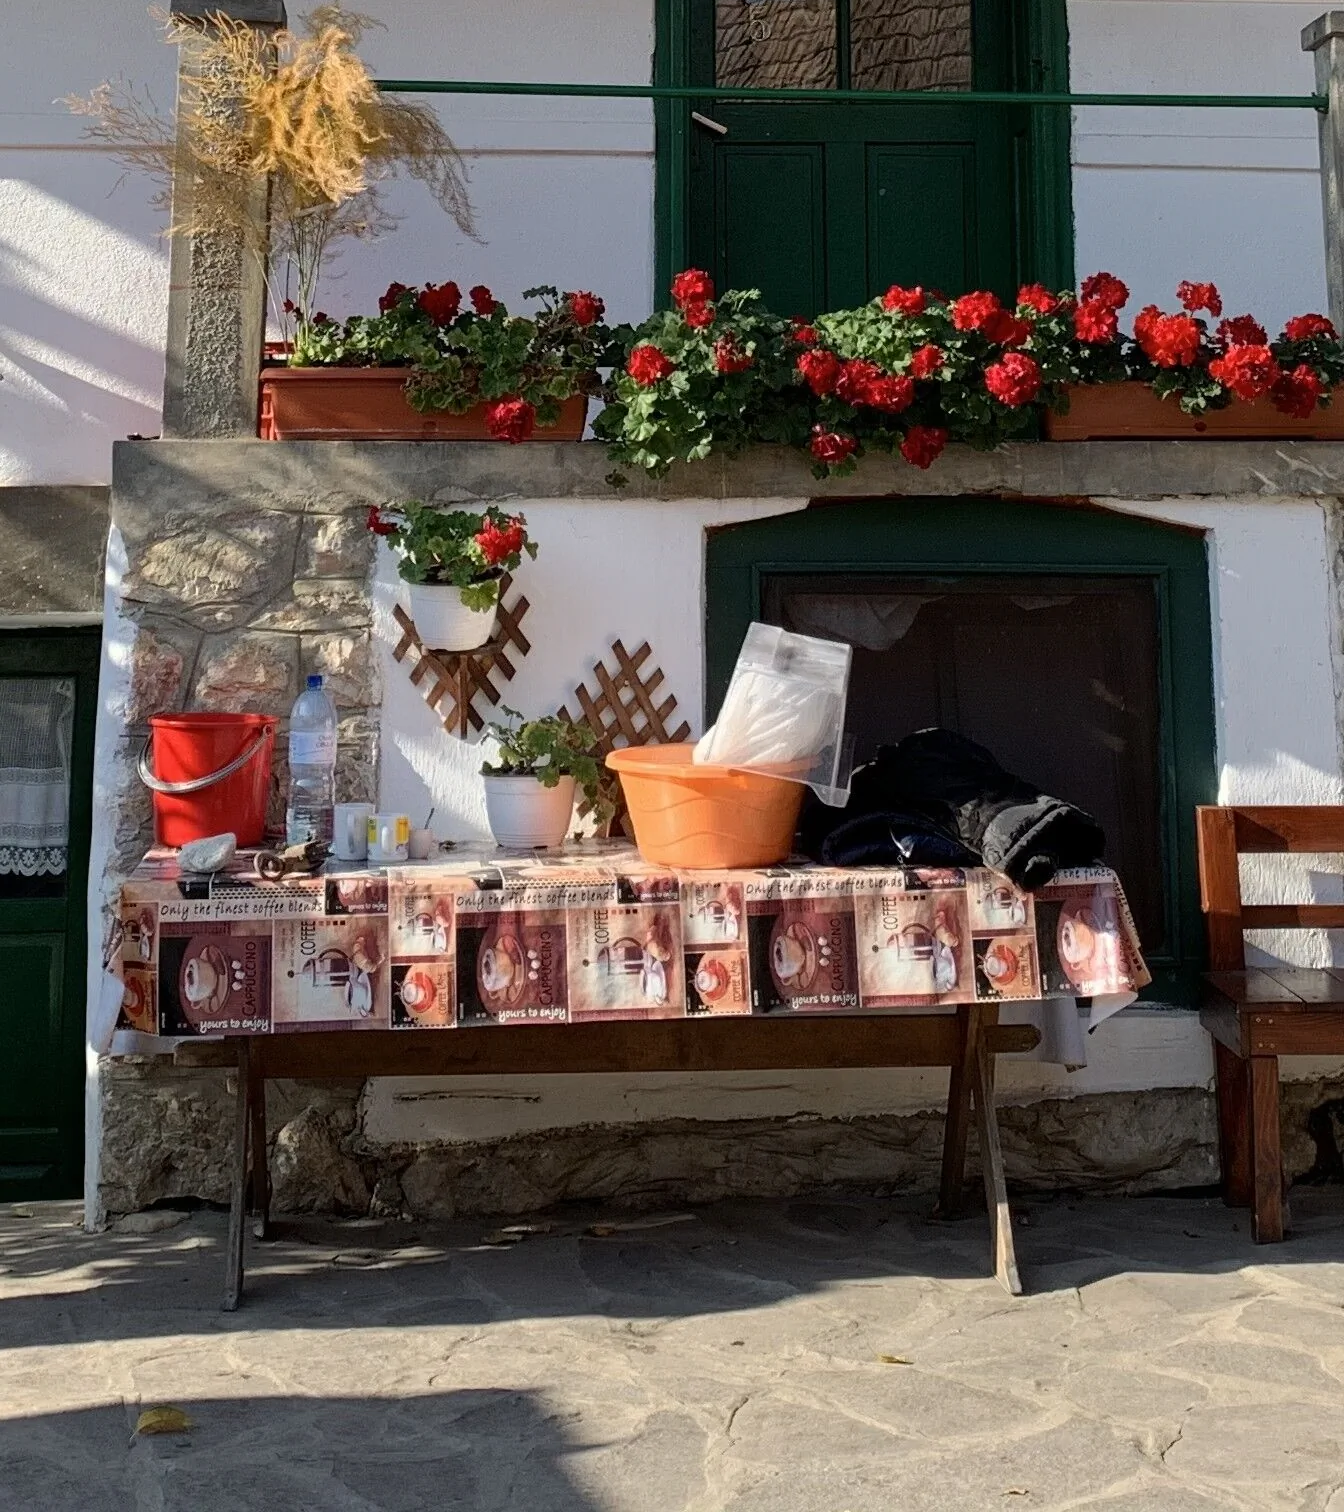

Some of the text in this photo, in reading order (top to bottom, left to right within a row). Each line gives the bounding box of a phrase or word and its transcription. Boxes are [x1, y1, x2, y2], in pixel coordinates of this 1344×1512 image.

[456, 888, 616, 912] Only the finest coffee blends
[746, 878, 777, 899] Only
[778, 879, 794, 893] the
[798, 878, 831, 896] finest
[835, 877, 865, 894] coffee
[160, 898, 323, 921] Only the finest coffee blends
[881, 896, 898, 931] COFFEE
[300, 920, 316, 956] COFFEE
[594, 909, 610, 944] COFFEE
[538, 930, 552, 1006] CAPPUCCINO
[830, 918, 844, 992] CAPPUCCINO
[242, 941, 257, 1017] CAPPUCCINO
[498, 1004, 566, 1023] yours to enjoy
[791, 991, 857, 1009] yours to enjoy
[199, 1015, 269, 1034] yours to enjoy
